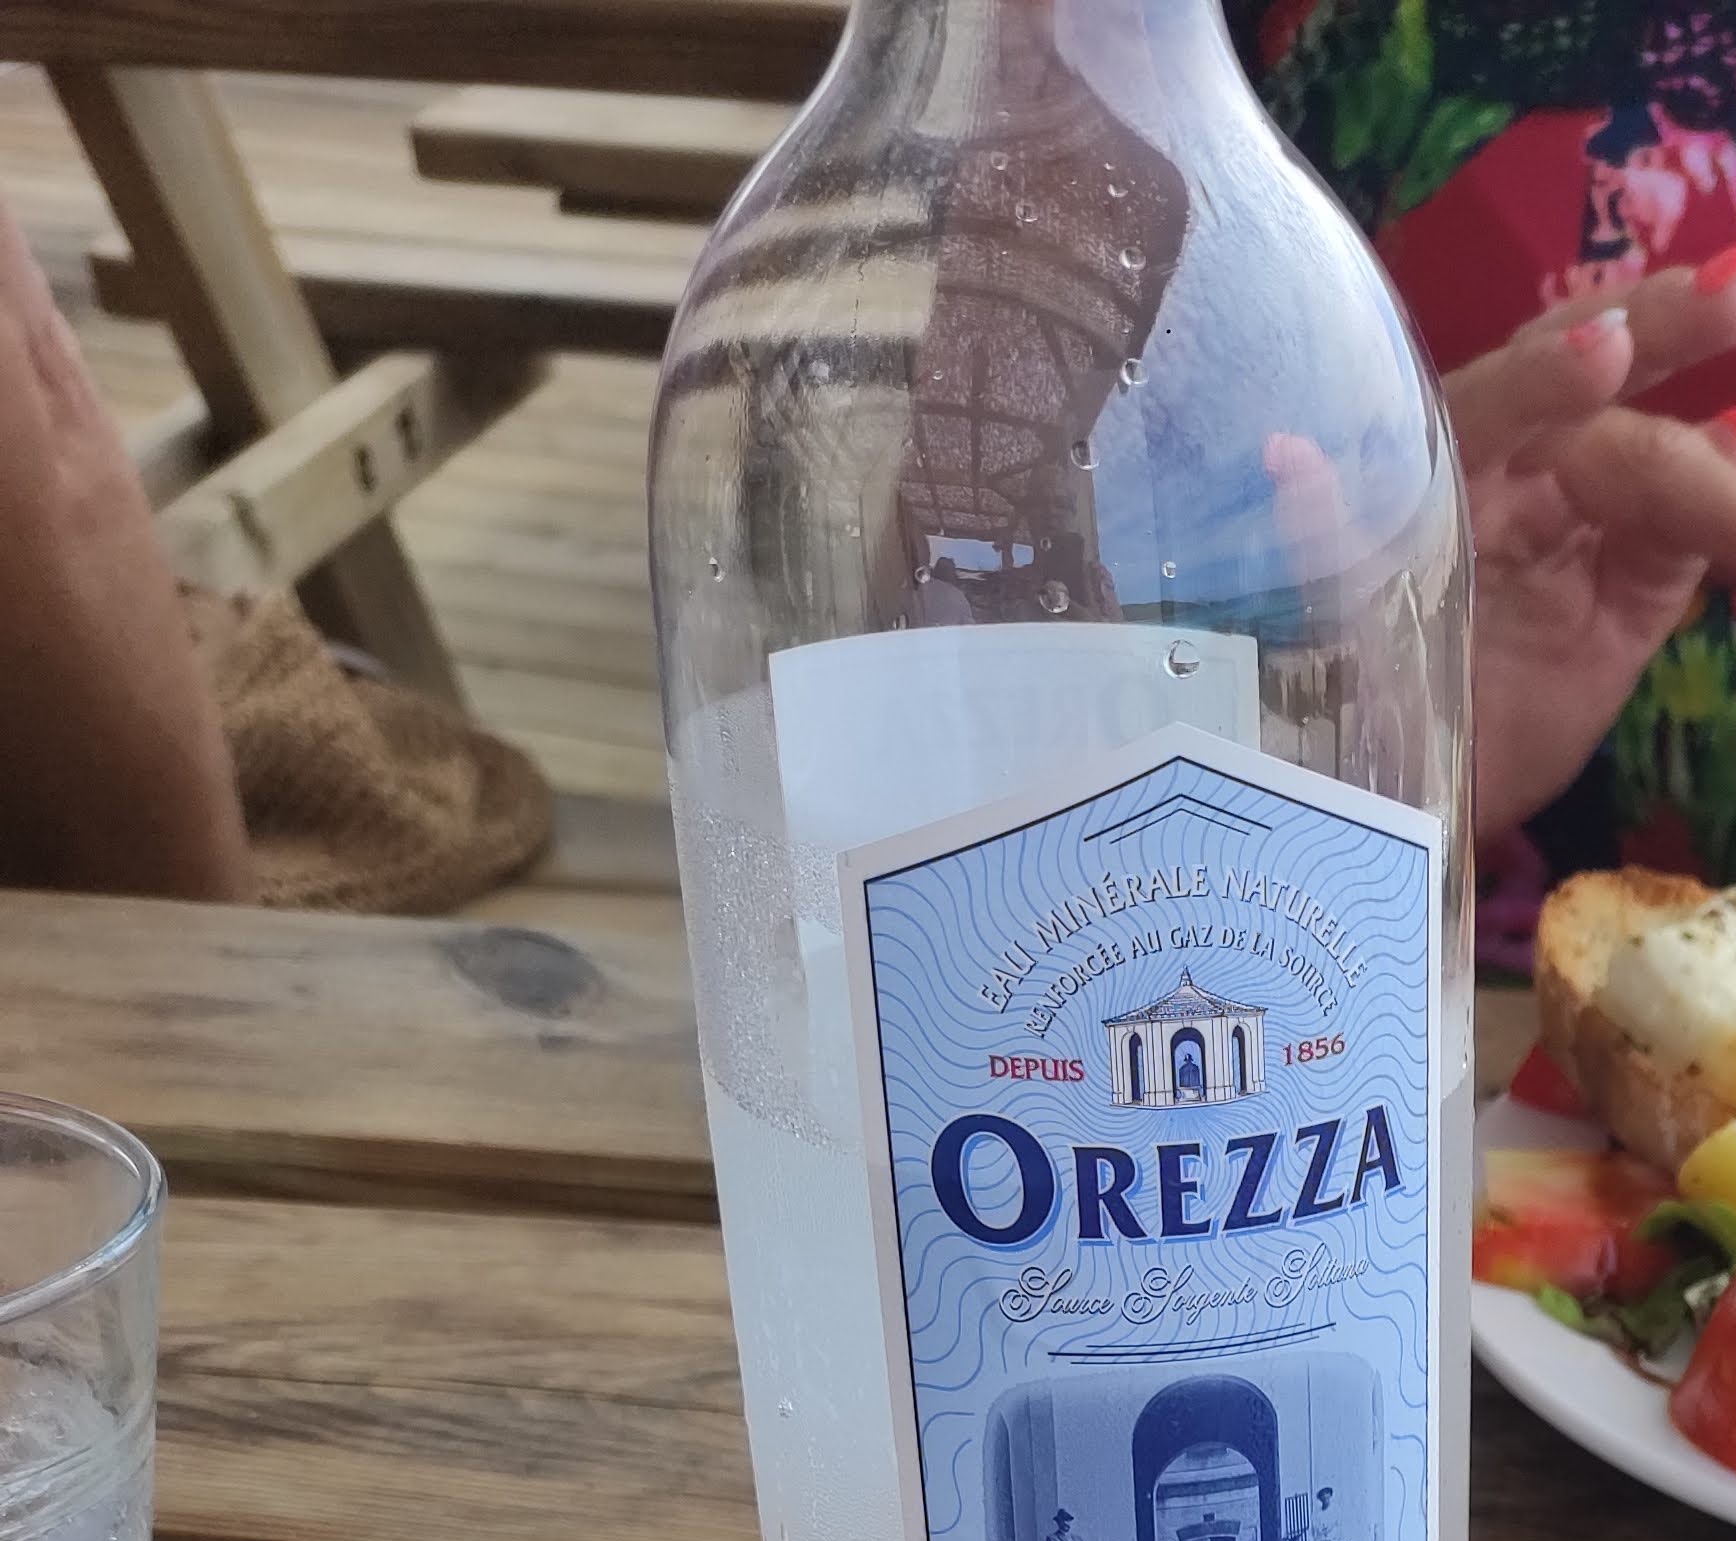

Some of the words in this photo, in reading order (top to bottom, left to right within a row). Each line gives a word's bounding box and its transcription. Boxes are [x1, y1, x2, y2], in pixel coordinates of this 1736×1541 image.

[977, 940, 1038, 1014] EAU
[1035, 863, 1211, 955] MINÉRALE
[1222, 865, 1368, 988] NATURELLE
[1024, 943, 1126, 1039] RENFORCÉE
[1131, 930, 1163, 959] AU
[1170, 924, 1213, 949] GAZ
[1218, 926, 1247, 951] DE
[1249, 932, 1275, 961] LA
[1278, 946, 1338, 1017] SOURCE
[989, 1054, 1085, 1083] DEPUIS
[1282, 1033, 1346, 1066] 1856
[930, 1103, 1405, 1248] OREZZA
[1001, 1266, 1115, 1323] Source
